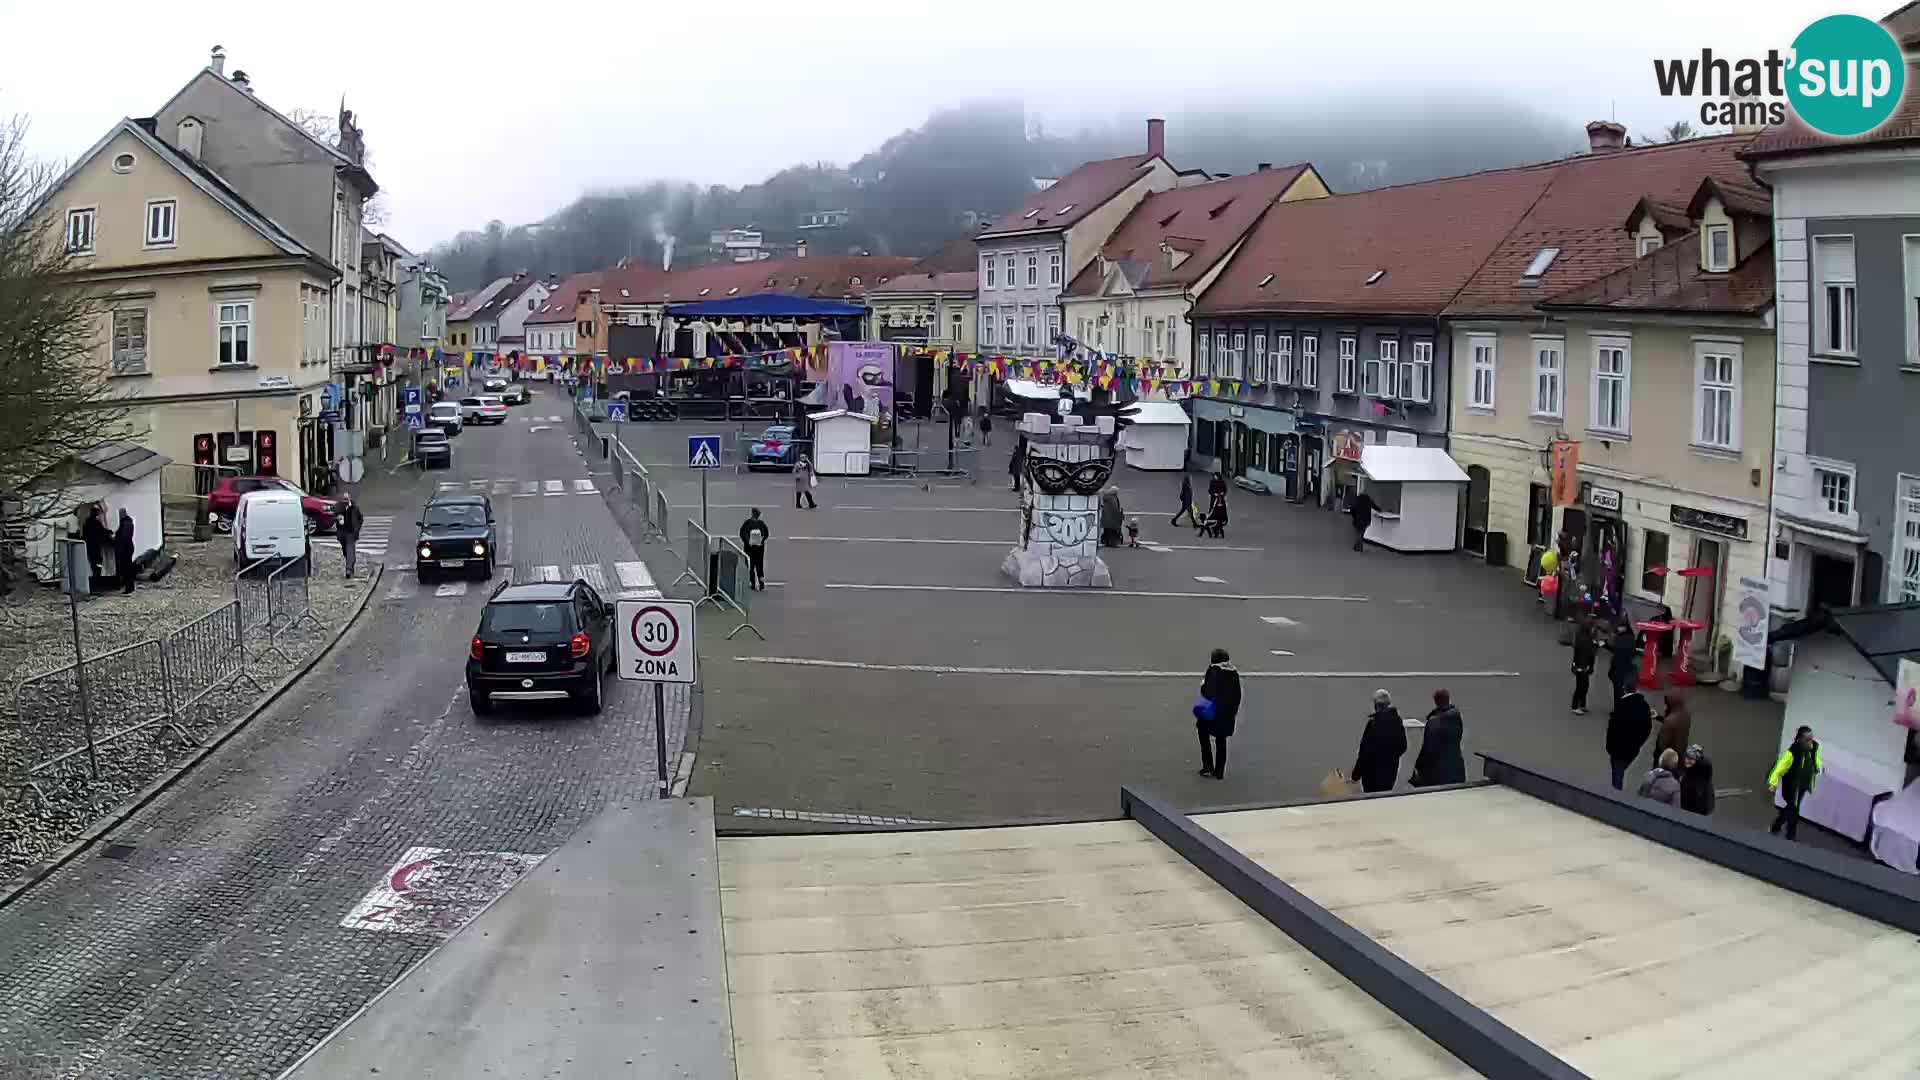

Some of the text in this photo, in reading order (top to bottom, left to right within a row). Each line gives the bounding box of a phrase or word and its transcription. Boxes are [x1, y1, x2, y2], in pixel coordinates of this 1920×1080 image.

[408, 391, 417, 402] P
[1047, 516, 1088, 545] 200
[644, 622, 668, 643] 30
[634, 659, 679, 676] ZONA
